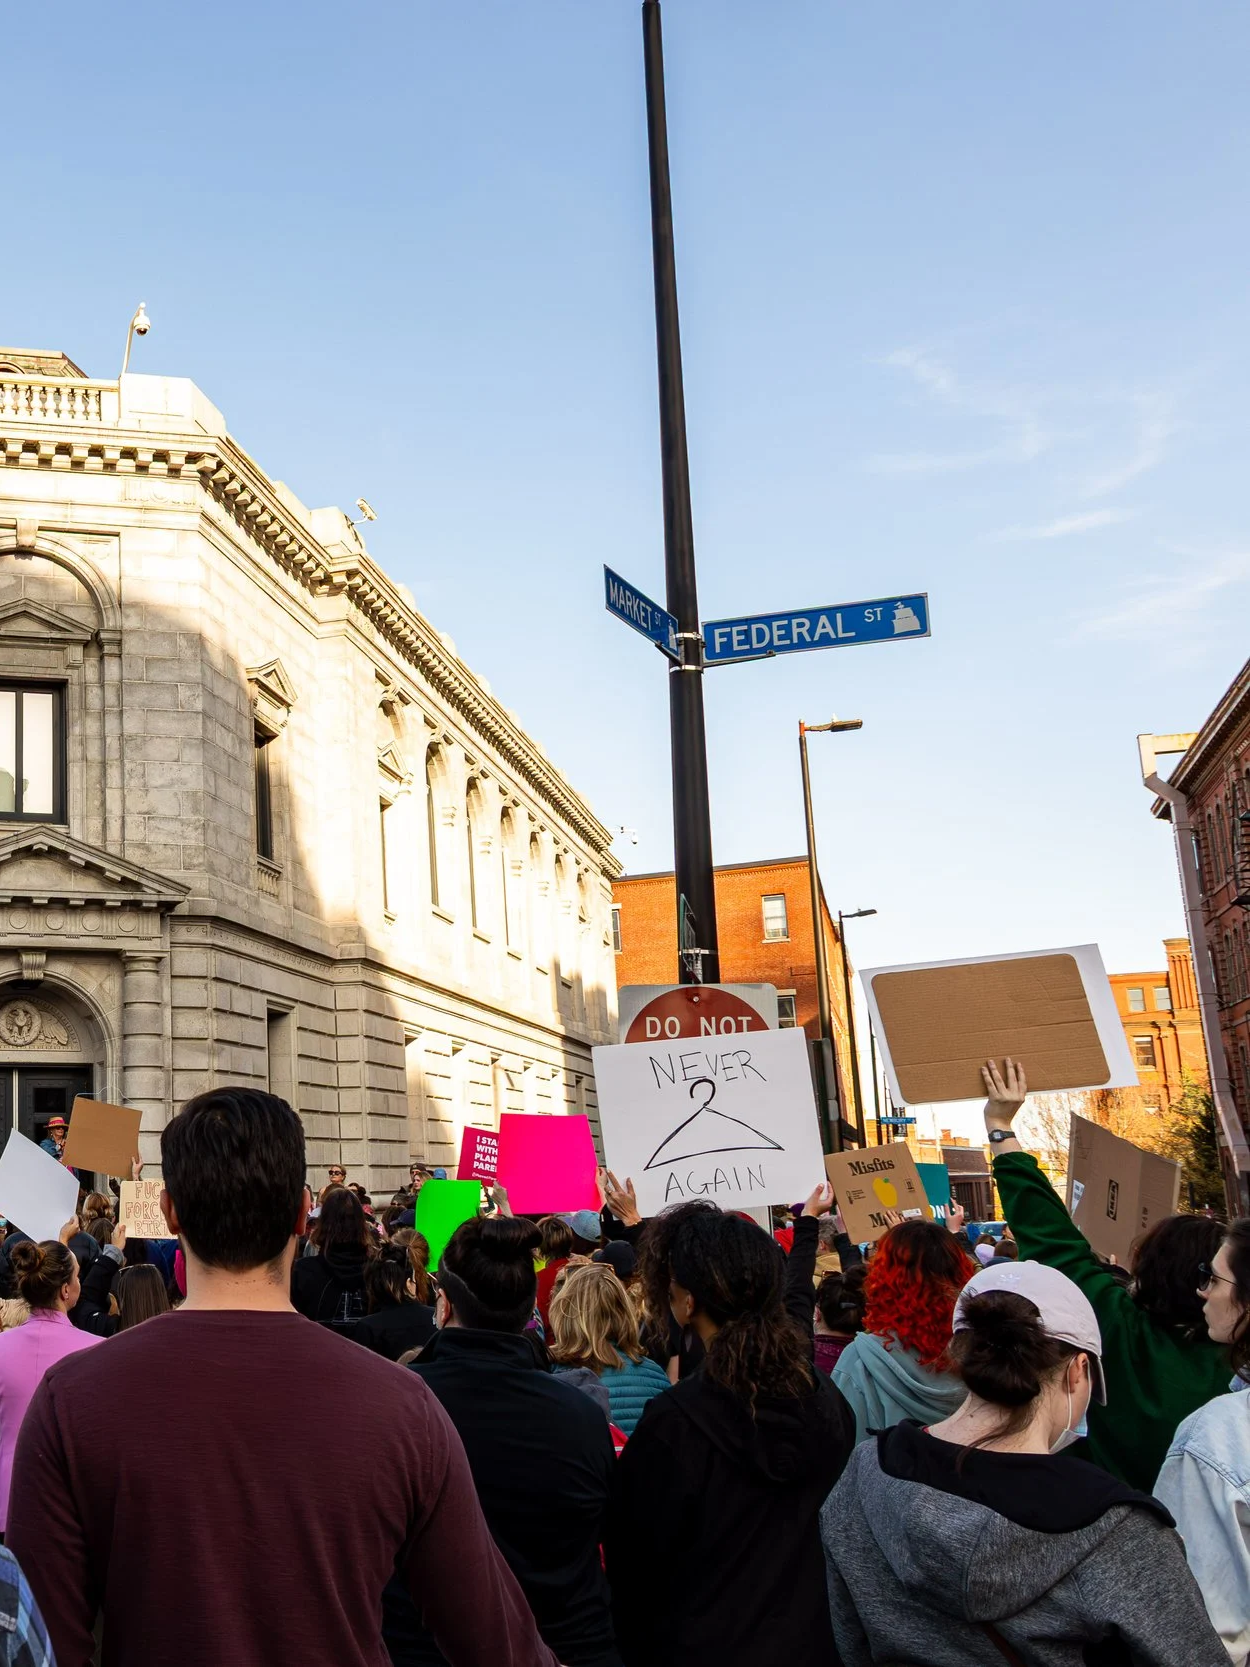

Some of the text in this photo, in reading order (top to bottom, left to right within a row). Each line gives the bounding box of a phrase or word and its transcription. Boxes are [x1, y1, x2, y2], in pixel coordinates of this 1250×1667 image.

[609, 577, 661, 631] MARKET ST
[714, 607, 883, 653] FEDERAL ST
[645, 1016, 752, 1038] DO NOT
[649, 1050, 767, 1089] NEVER
[476, 1135, 481, 1143] I
[476, 1144, 499, 1156] WITH
[474, 1152, 498, 1164] PLAN
[847, 1157, 895, 1177] Misfits
[664, 1164, 766, 1202] AGAIN
[1107, 1181, 1118, 1218] IKEA
[135, 1220, 168, 1237] BIRT
